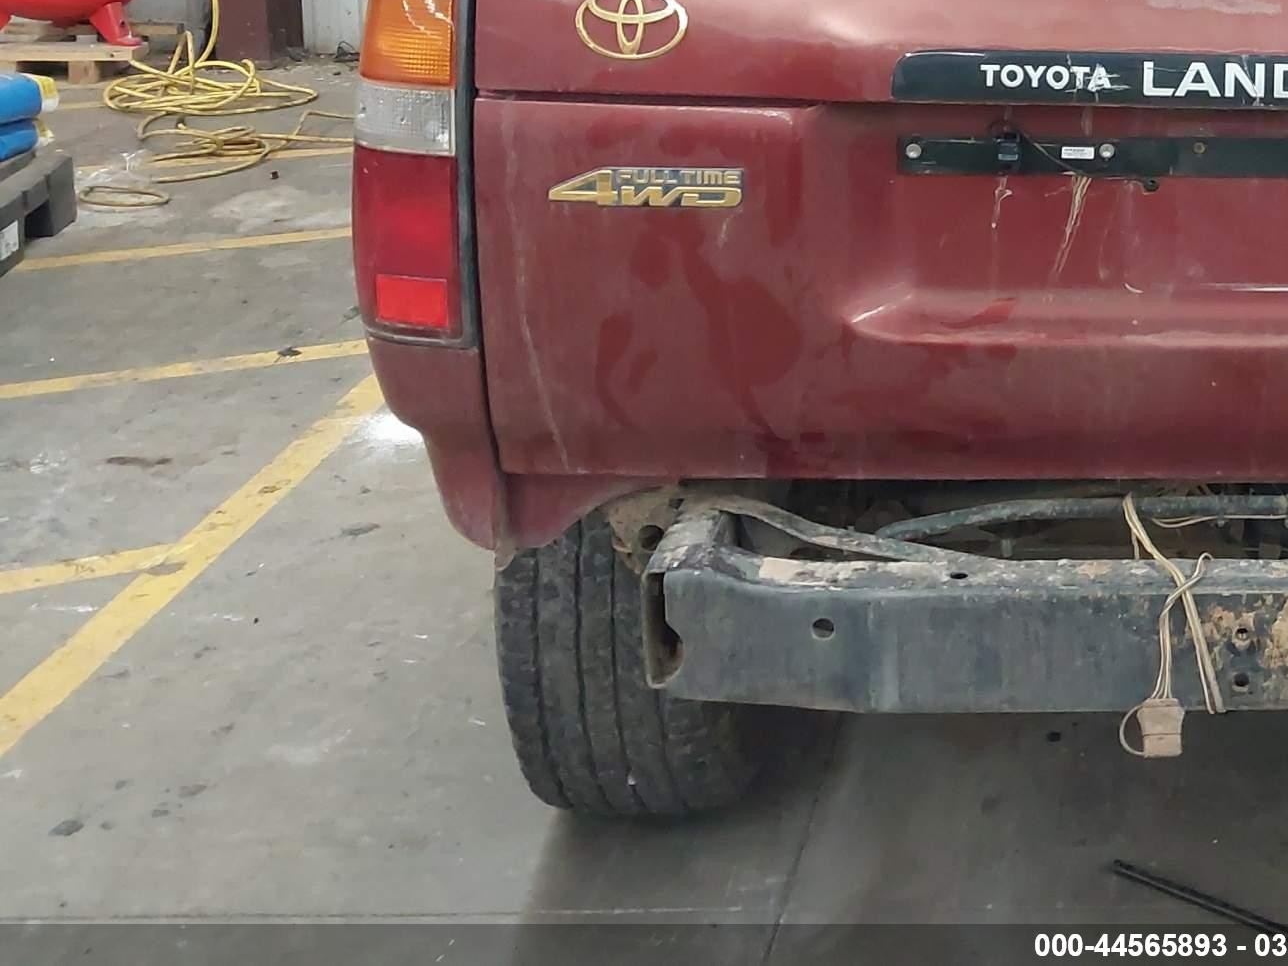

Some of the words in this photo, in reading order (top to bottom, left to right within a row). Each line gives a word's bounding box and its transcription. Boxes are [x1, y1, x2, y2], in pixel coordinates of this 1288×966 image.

[981, 64, 1112, 89] TOYOTA
[548, 170, 743, 207] 4WD
[616, 170, 678, 184] FULL
[680, 170, 741, 184] TIME
